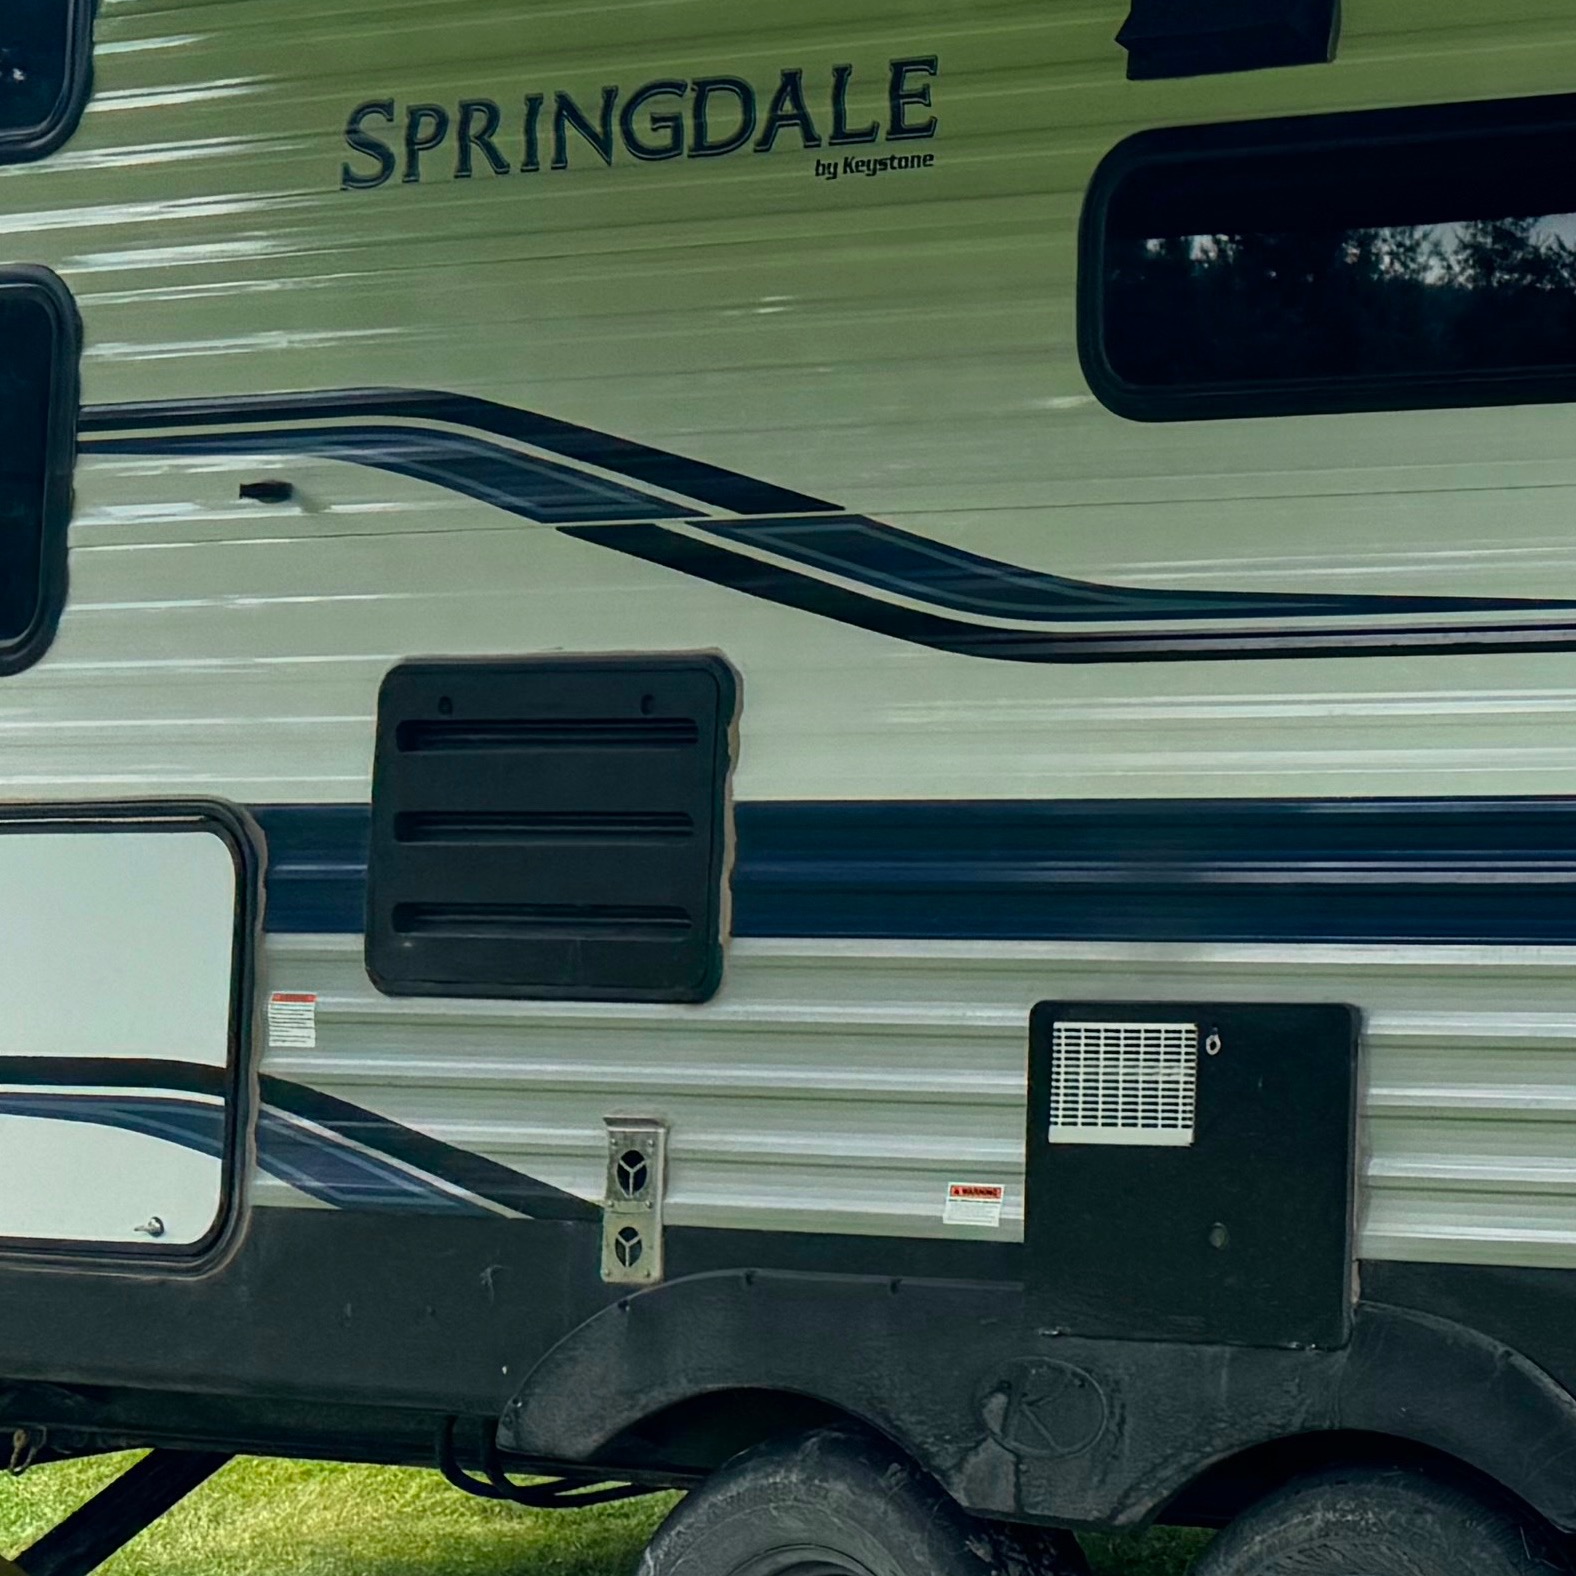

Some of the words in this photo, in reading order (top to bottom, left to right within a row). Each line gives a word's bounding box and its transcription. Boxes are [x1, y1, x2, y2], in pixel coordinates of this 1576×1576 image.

[340, 55, 939, 191] SPRINGDALE
[815, 159, 838, 180] by
[843, 153, 935, 177] Keystone
